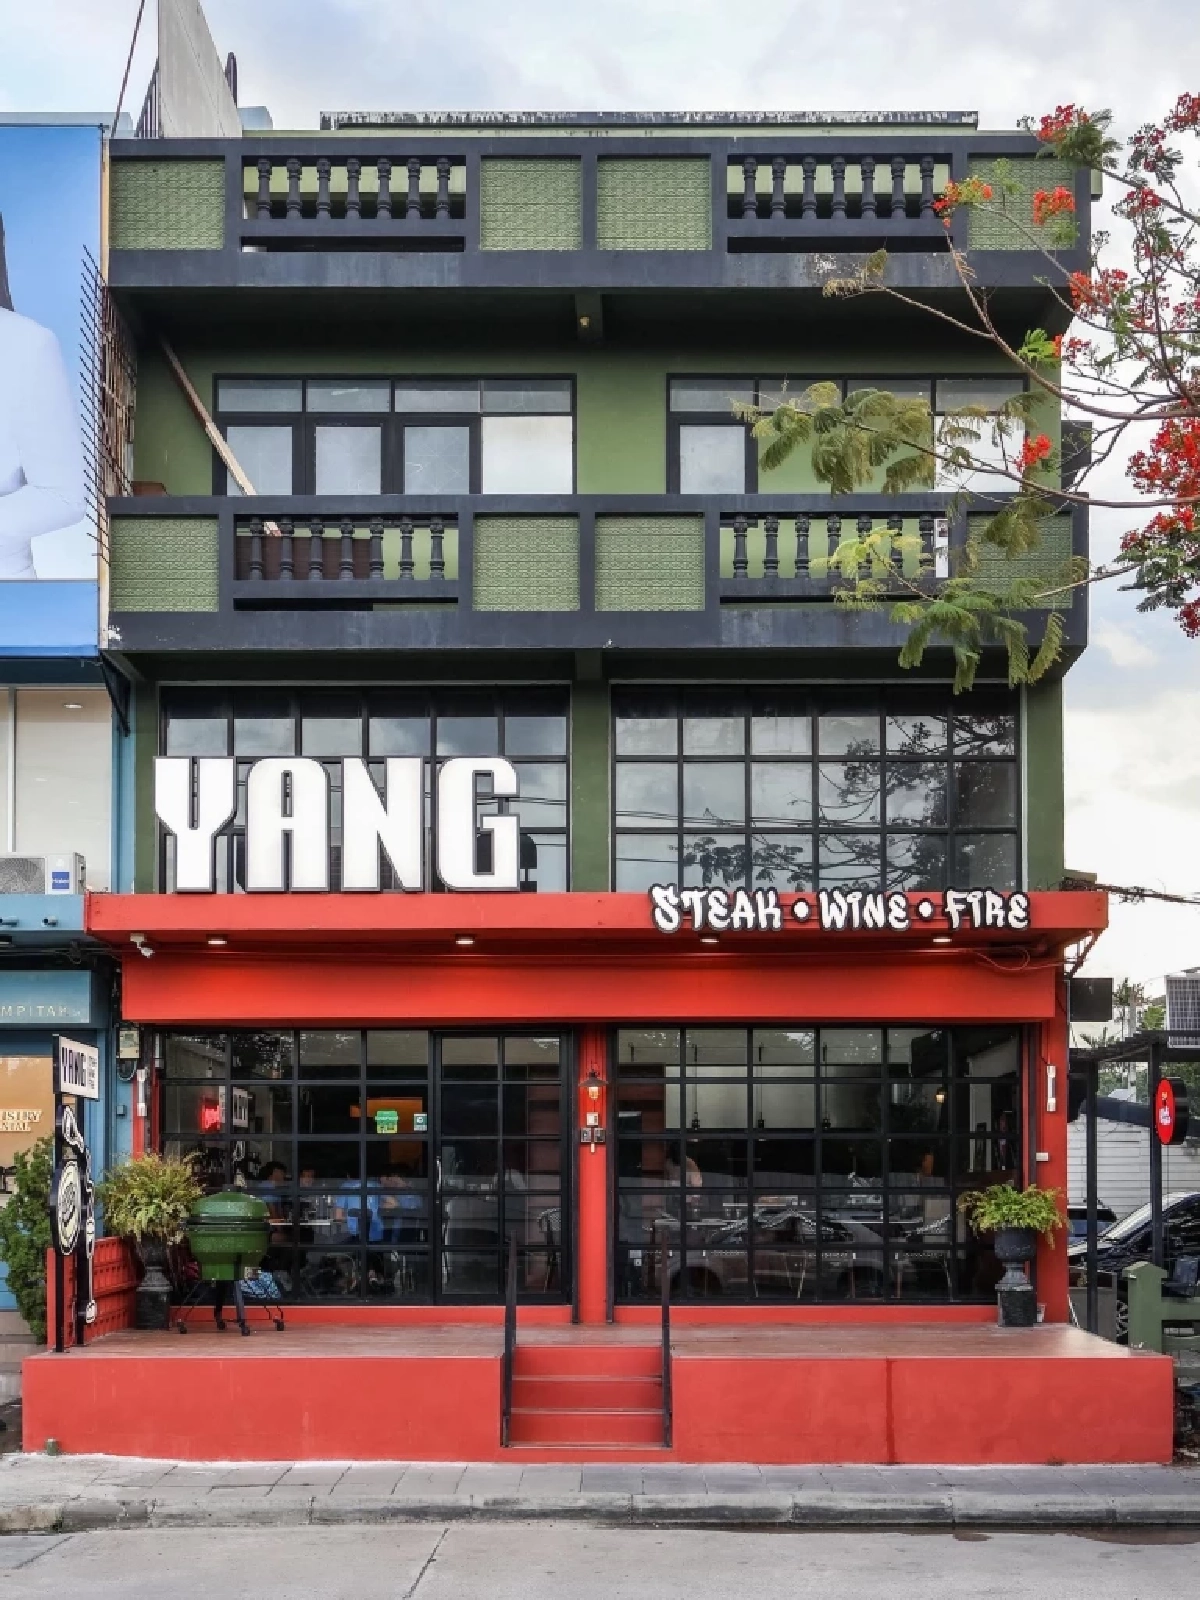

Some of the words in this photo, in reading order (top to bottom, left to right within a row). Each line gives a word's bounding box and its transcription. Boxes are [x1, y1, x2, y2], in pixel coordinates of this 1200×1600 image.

[153, 756, 521, 893] YANG
[650, 884, 783, 933] STEAK
[818, 887, 911, 932] WINE
[943, 887, 1031, 931] FIRE
[61, 1046, 87, 1087] YANG
